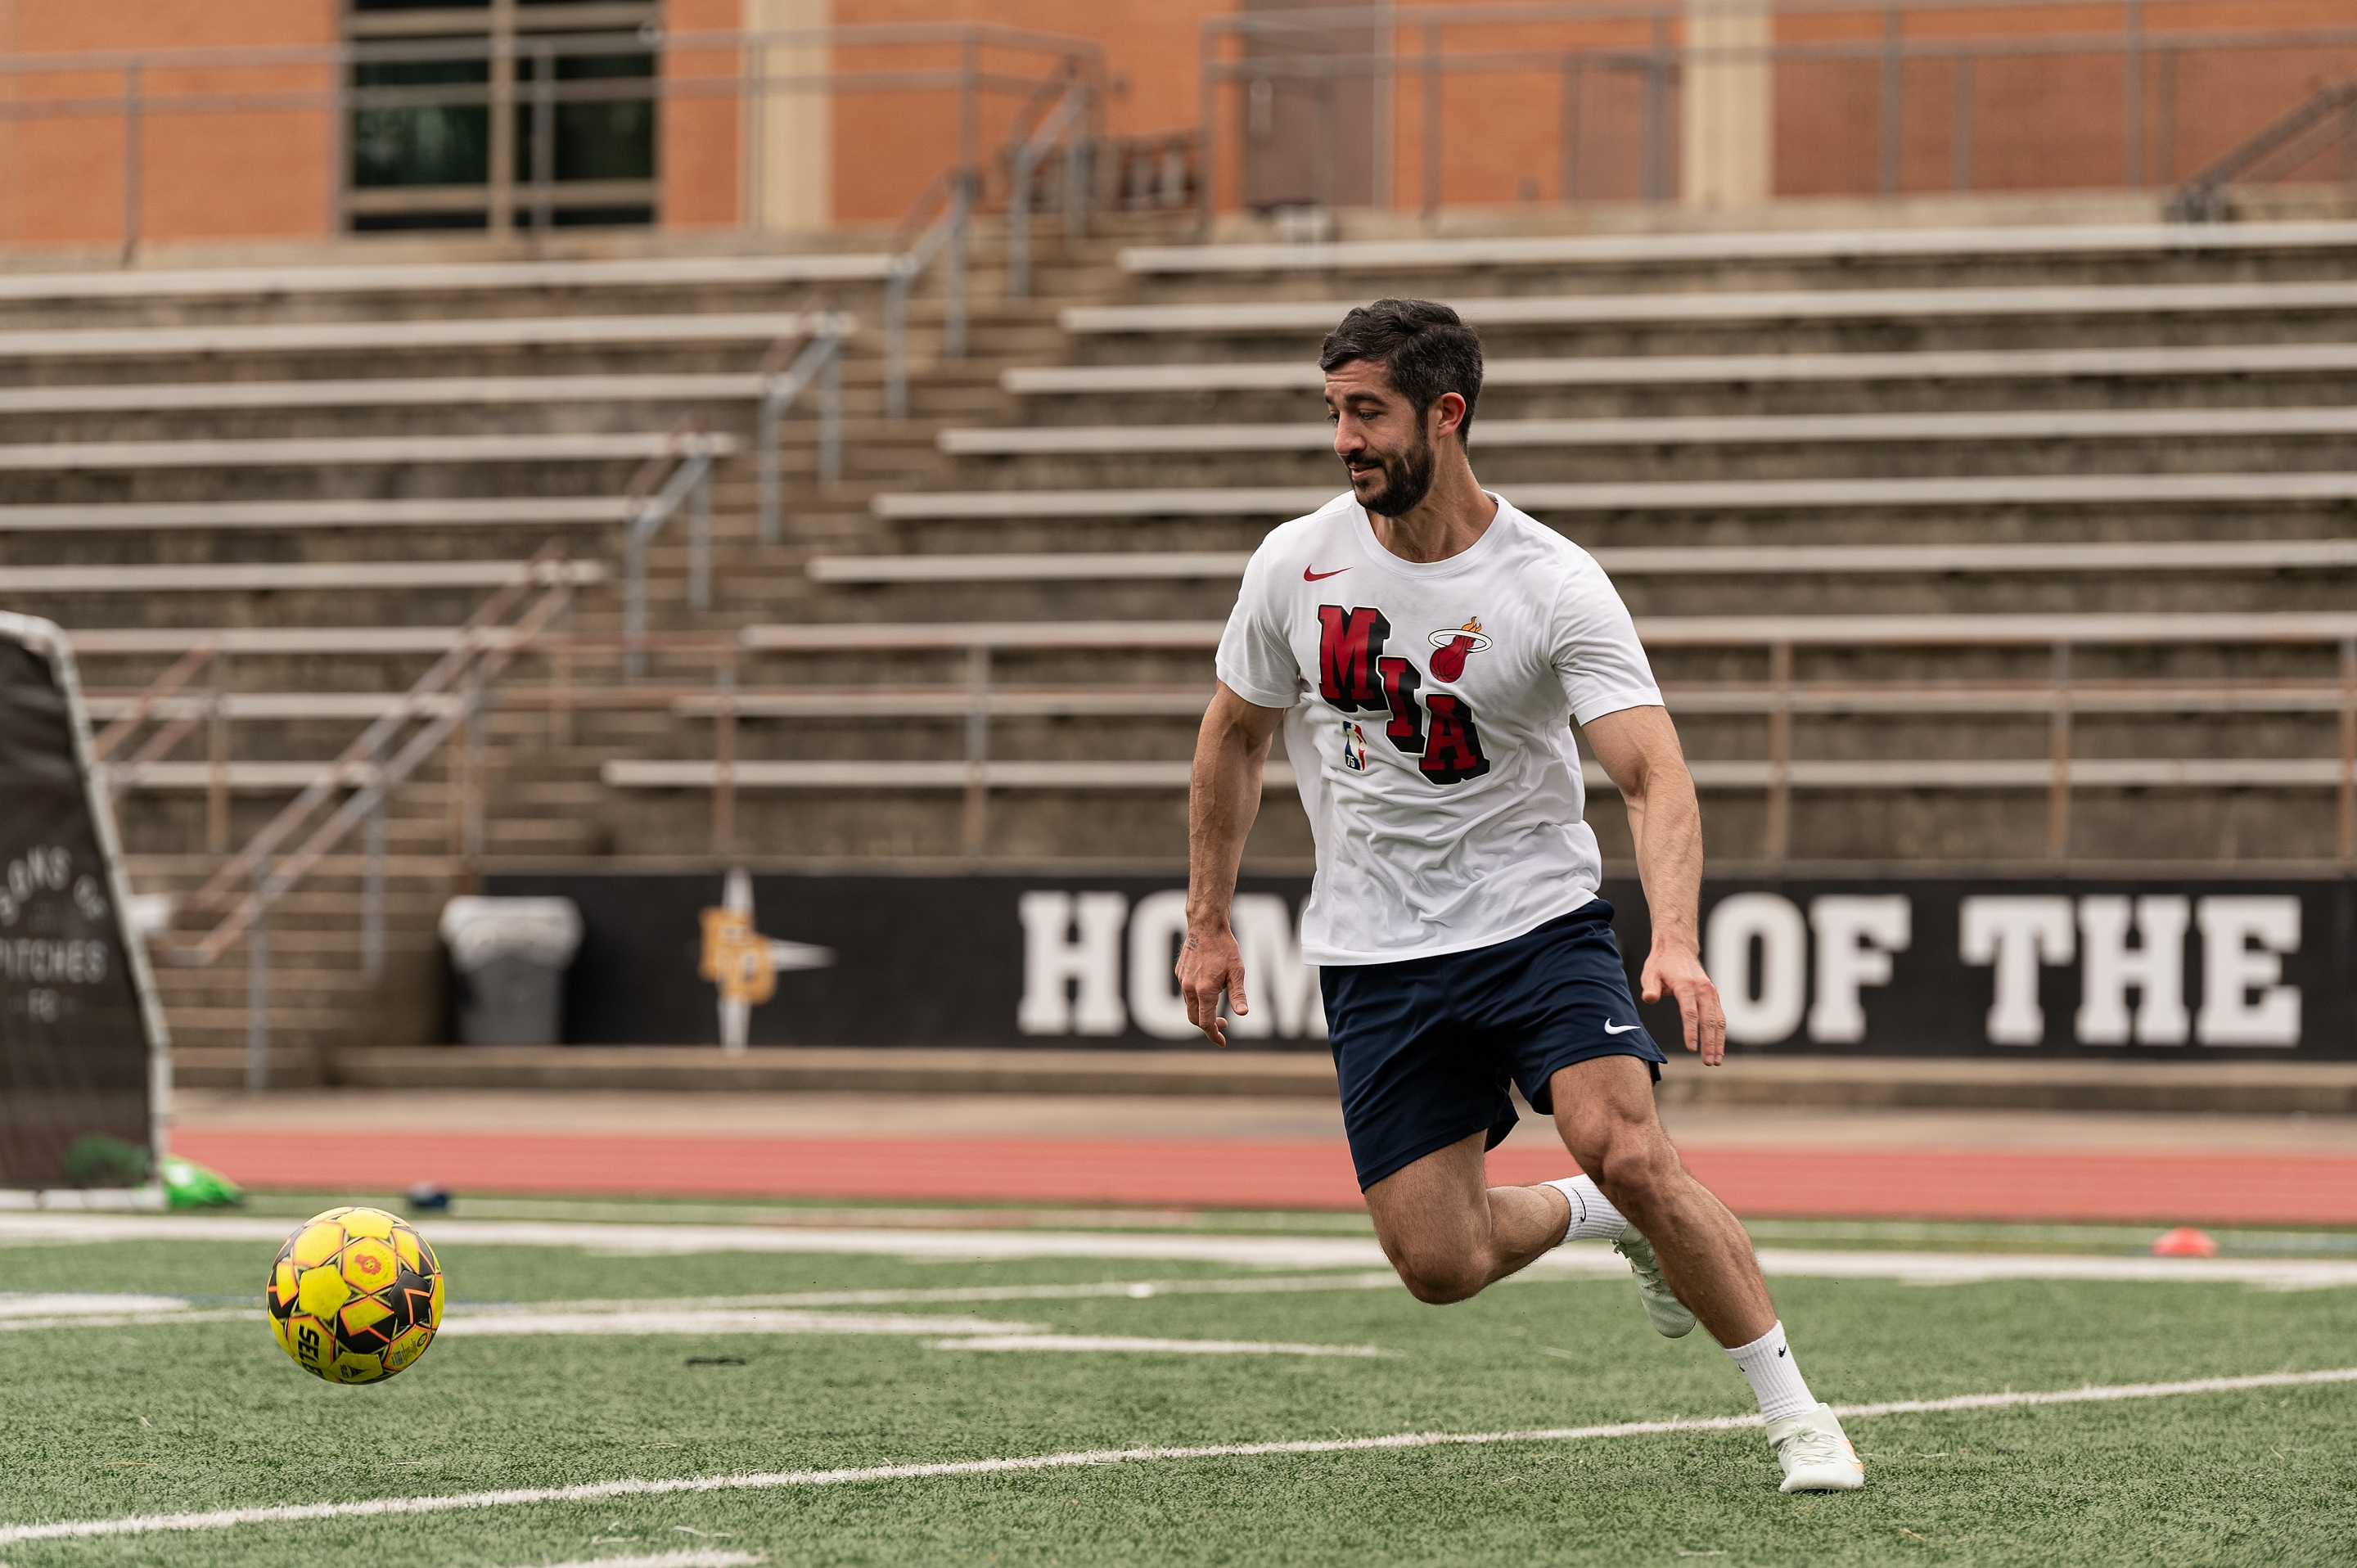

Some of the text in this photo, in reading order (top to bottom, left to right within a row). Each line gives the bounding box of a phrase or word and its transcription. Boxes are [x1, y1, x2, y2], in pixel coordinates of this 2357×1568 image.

[1318, 603, 1490, 785] MIA
[1345, 754, 1355, 768] 75
[1017, 889, 2302, 1046] HOM OF THE
